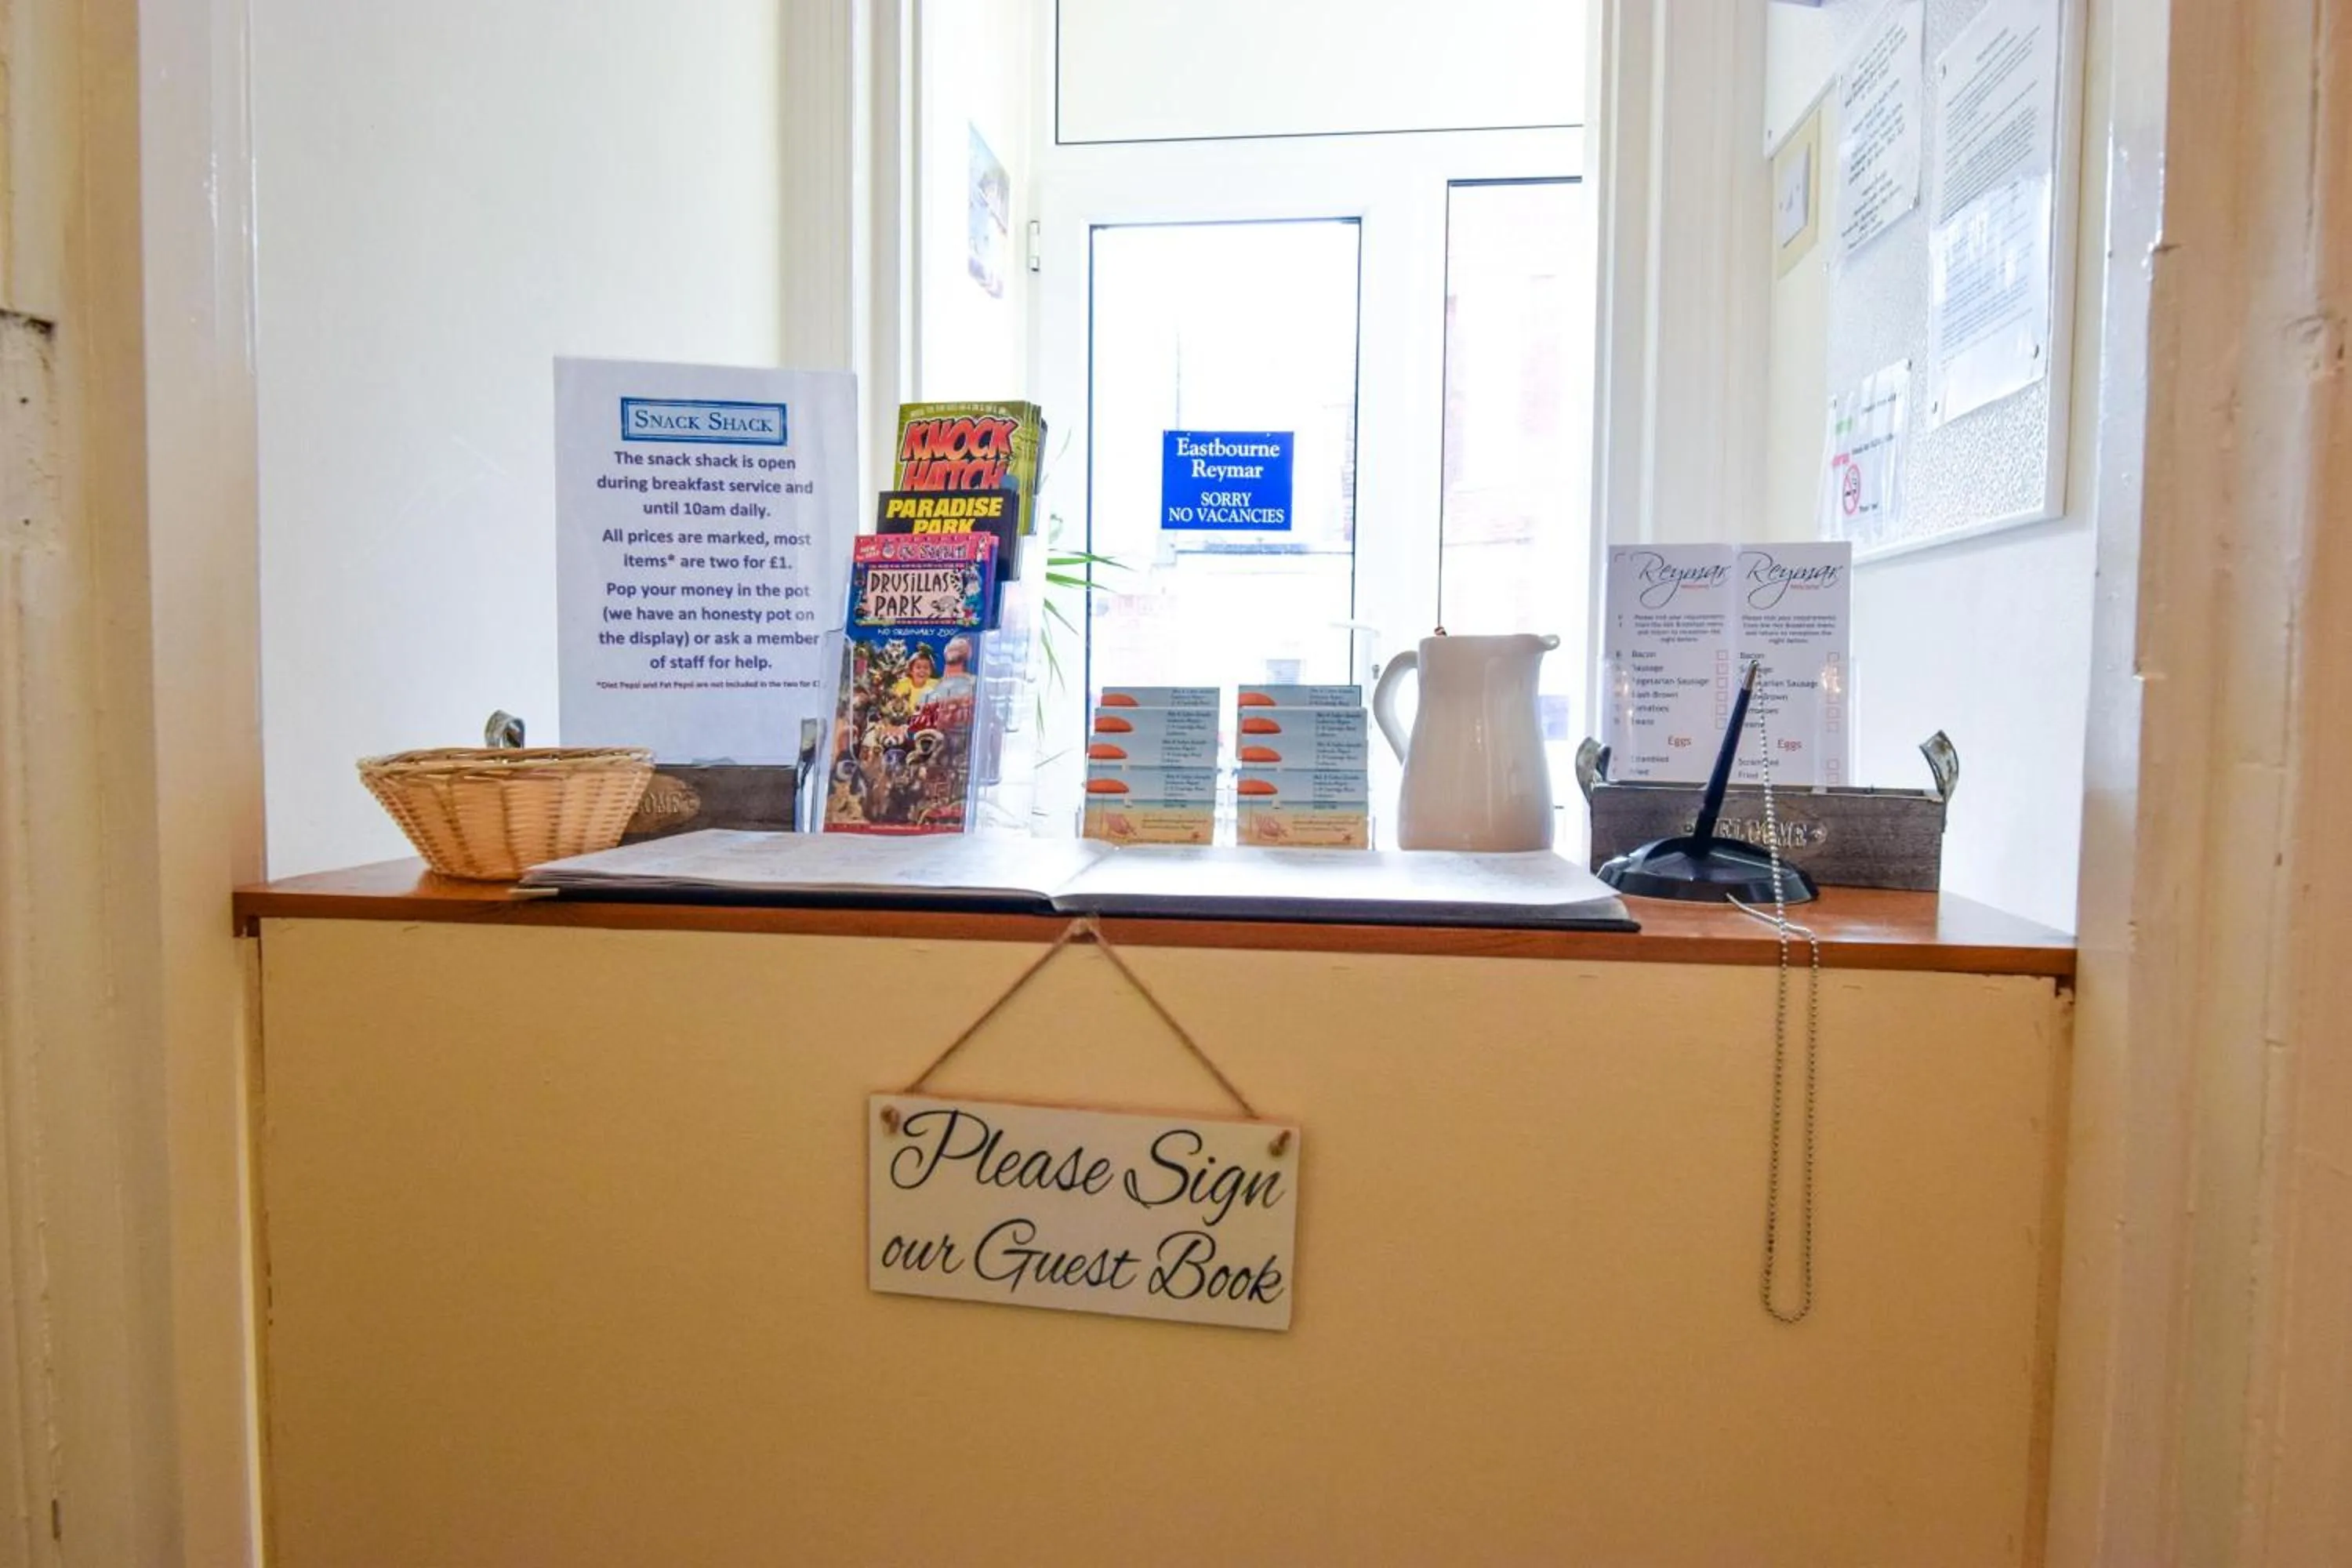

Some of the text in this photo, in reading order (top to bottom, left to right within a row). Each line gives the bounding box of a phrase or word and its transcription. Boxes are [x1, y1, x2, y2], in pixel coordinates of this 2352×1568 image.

[634, 409, 773, 432] SNACK SHACK
[902, 416, 1018, 460] KNOCK
[1177, 437, 1280, 458] Eastbourne
[615, 451, 797, 471] The snack shack is open
[1191, 459, 1264, 482] Reymar
[902, 459, 1008, 489] HATCH
[597, 475, 813, 494] during breakfast service and
[886, 497, 1004, 518] PARADISE
[1200, 492, 1251, 506] SORRY
[643, 501, 771, 519] until 10am daily.
[1169, 507, 1285, 524] NO VACANCIES
[912, 518, 975, 534] PARK
[602, 528, 811, 547] All prices are marked, most
[680, 557, 705, 568] are
[710, 557, 739, 569] two
[743, 554, 765, 568] for
[770, 556, 793, 569] £1.
[1631, 551, 1731, 610] Reymar
[1737, 551, 1843, 611] Reymar
[606, 583, 811, 600] Pop your money in the pot
[603, 606, 815, 624] (we have an honesty pot on
[874, 594, 923, 617] PARK
[599, 630, 820, 648] the display) or ask a member
[650, 655, 772, 672] of staff for help.
[1777, 739, 1803, 752] Eggs
[891, 1109, 1286, 1226] Please Sign
[882, 1218, 1286, 1304] our Guest Book
